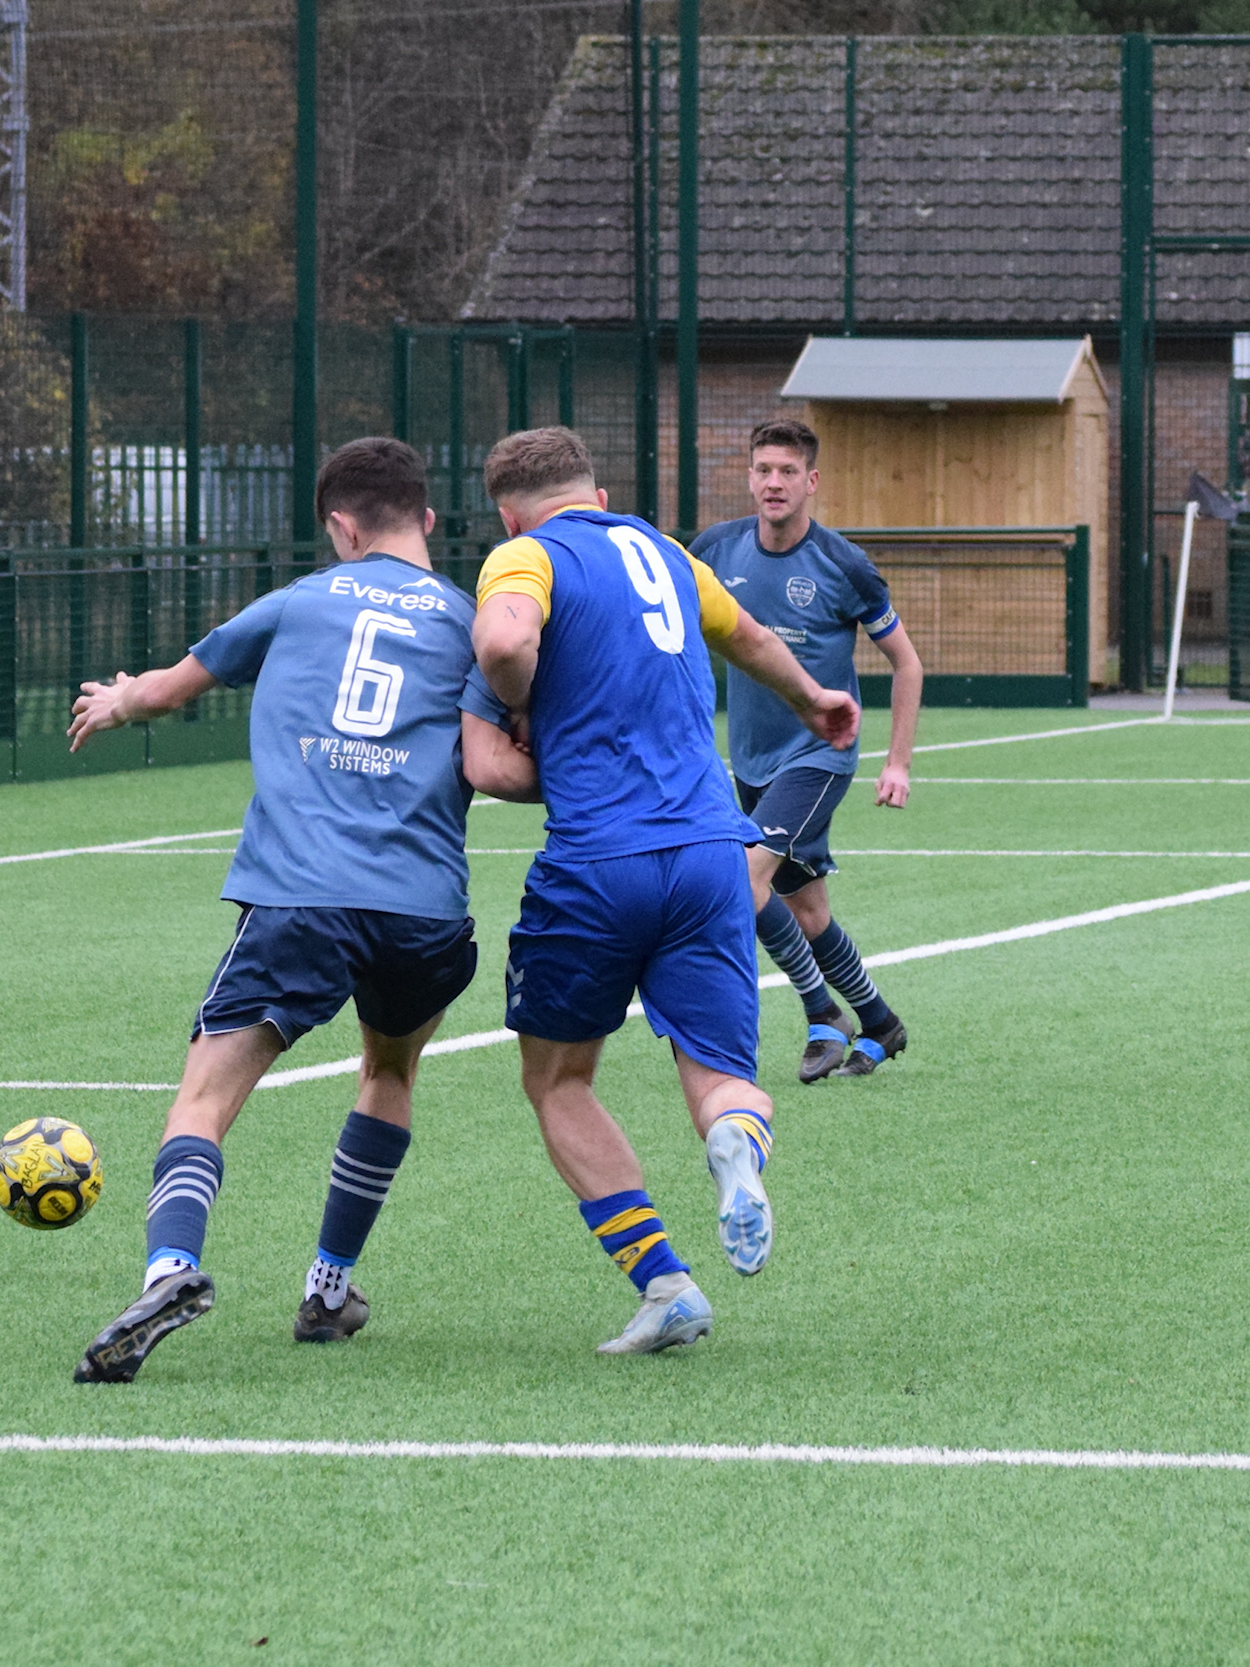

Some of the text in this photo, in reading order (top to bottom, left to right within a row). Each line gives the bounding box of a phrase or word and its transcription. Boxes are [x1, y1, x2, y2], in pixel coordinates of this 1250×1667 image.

[329, 576, 449, 611] Everest
[607, 525, 685, 655] 9
[332, 608, 417, 738] 6
[320, 738, 410, 766] W2 WINDOW
[329, 754, 391, 776] SYSTEMS
